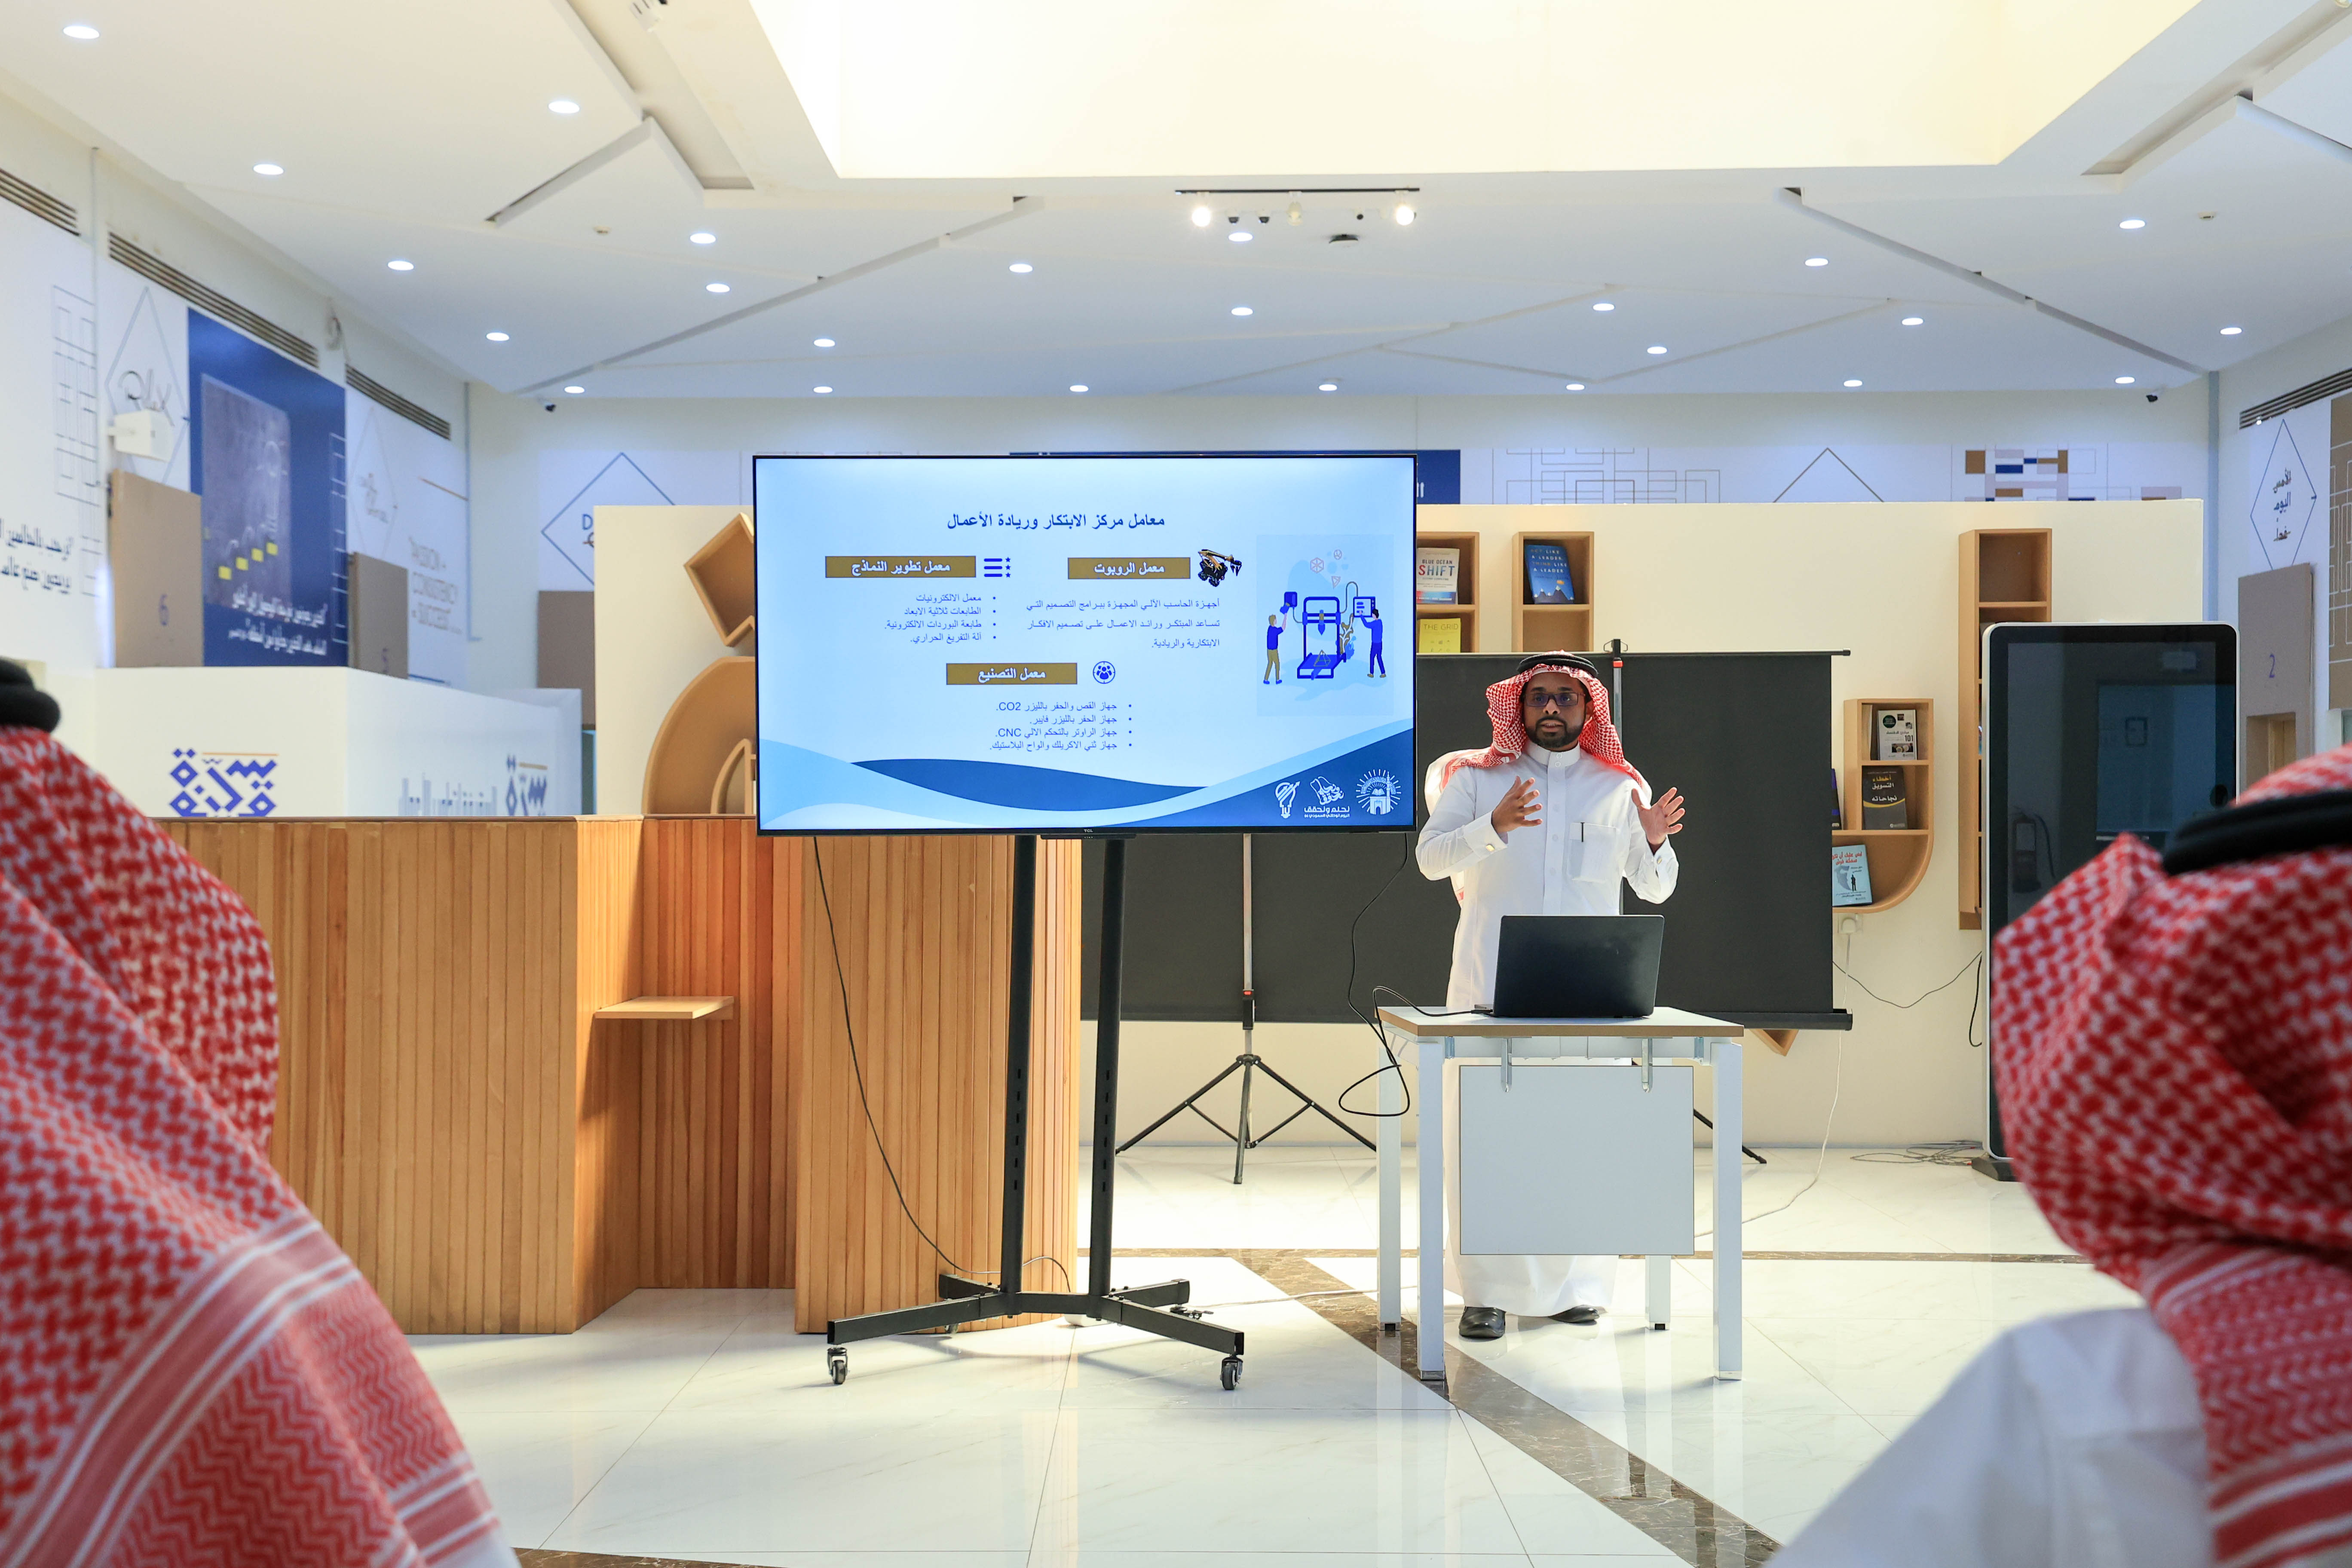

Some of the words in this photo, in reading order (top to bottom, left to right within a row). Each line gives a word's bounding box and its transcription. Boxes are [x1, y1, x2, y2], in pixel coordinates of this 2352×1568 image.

[947, 511, 992, 530] الأعمال
[998, 513, 1038, 530] وريادة
[1043, 513, 1086, 530] الابتكار
[1091, 514, 1124, 530] مركز
[1128, 512, 1165, 529] معامل
[852, 559, 887, 576] النماذج
[891, 560, 921, 574] تطوير
[924, 560, 950, 574] معمل
[1094, 562, 1135, 576] الروبوت
[1139, 562, 1164, 575] معمل
[1418, 564, 1455, 576] SHIFT
[916, 594, 959, 603] الالكترونيات
[962, 593, 982, 603] معمل
[1195, 598, 1219, 609] أجهزة
[1026, 600, 1043, 611] التي
[1046, 600, 1076, 610] التصميم
[1079, 600, 1105, 611] ببرامج
[1107, 600, 1138, 609] المجهزة
[1140, 599, 1161, 611] الألي
[1164, 599, 1193, 609] الحاسب
[158, 594, 169, 626] 6
[904, 607, 925, 616] الابعاد
[928, 607, 948, 616] ثلاثية
[950, 606, 981, 616] الطابعات
[885, 620, 924, 630] الالكترونية.
[927, 620, 958, 630] البوردات
[961, 619, 982, 629] طابعة
[1027, 620, 1054, 630] الافكار
[1057, 621, 1083, 631] تصميم
[1086, 619, 1103, 630] على
[1107, 619, 1136, 628] الاعمال
[1140, 620, 1163, 629] ورائد
[1166, 619, 1192, 629] المبتكر
[910, 633, 943, 644] الحراري.
[946, 633, 969, 644] التفريغ
[1152, 638, 1185, 649] والريادية.
[1187, 638, 1219, 649] الابتكارية
[2269, 654, 2276, 678] 2
[978, 667, 1016, 683] التصنيع
[1020, 667, 1045, 680] معمل
[996, 701, 1021, 711] CO2.
[1024, 701, 1047, 712] بالليزر
[1051, 701, 1074, 711] والحفر
[1076, 701, 1096, 711] القص
[1100, 701, 1117, 711] جهاز
[1029, 715, 1049, 725] فايبر.
[1052, 715, 1075, 725] بالليزر
[1078, 715, 1096, 725] الحفر
[1100, 715, 1118, 725] جهاز
[995, 728, 1022, 737] CNC.
[1024, 728, 1041, 739] الالي
[1044, 727, 1069, 738] بالتحكم
[1072, 727, 1096, 738] الراوتر
[1100, 728, 1118, 738] جهاز
[989, 741, 1023, 750] البلاستيك.
[1026, 741, 1049, 752] والواح
[1052, 740, 1081, 750] الاكريلك
[1084, 740, 1096, 752] ثني
[1100, 741, 1118, 750] جهاز
